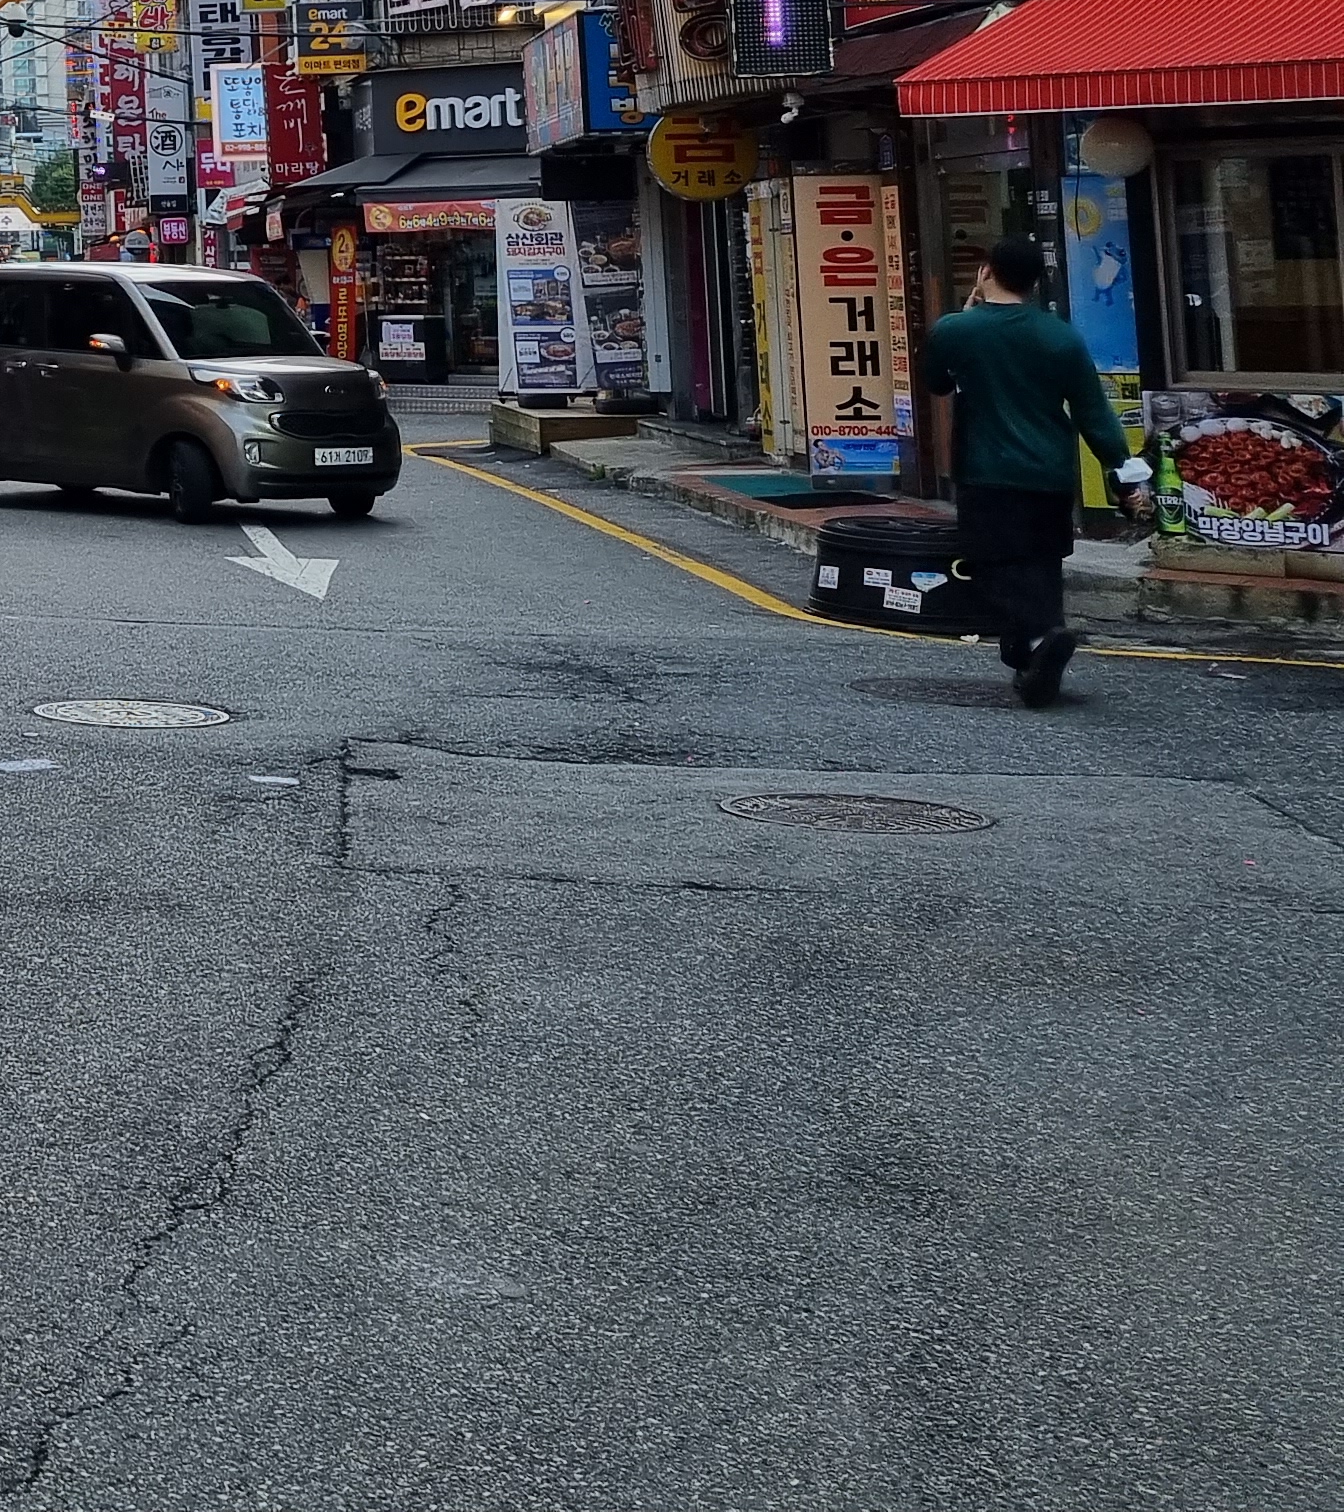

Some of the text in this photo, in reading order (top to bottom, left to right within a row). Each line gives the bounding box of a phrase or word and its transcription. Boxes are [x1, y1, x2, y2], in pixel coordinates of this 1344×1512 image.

[308, 8, 348, 21] emart
[308, 21, 349, 50] 24
[303, 59, 361, 71] 이마트 편의점
[148, 108, 167, 121] The
[395, 88, 525, 132] emart
[672, 169, 743, 187] 거래소
[163, 222, 186, 240] 부동산
[506, 232, 564, 247] 삼산회관
[816, 185, 880, 288] 금·은
[828, 296, 882, 422] 거래소
[811, 425, 898, 438] 010-8700-440
[1198, 515, 1331, 546] 막창양념구이
